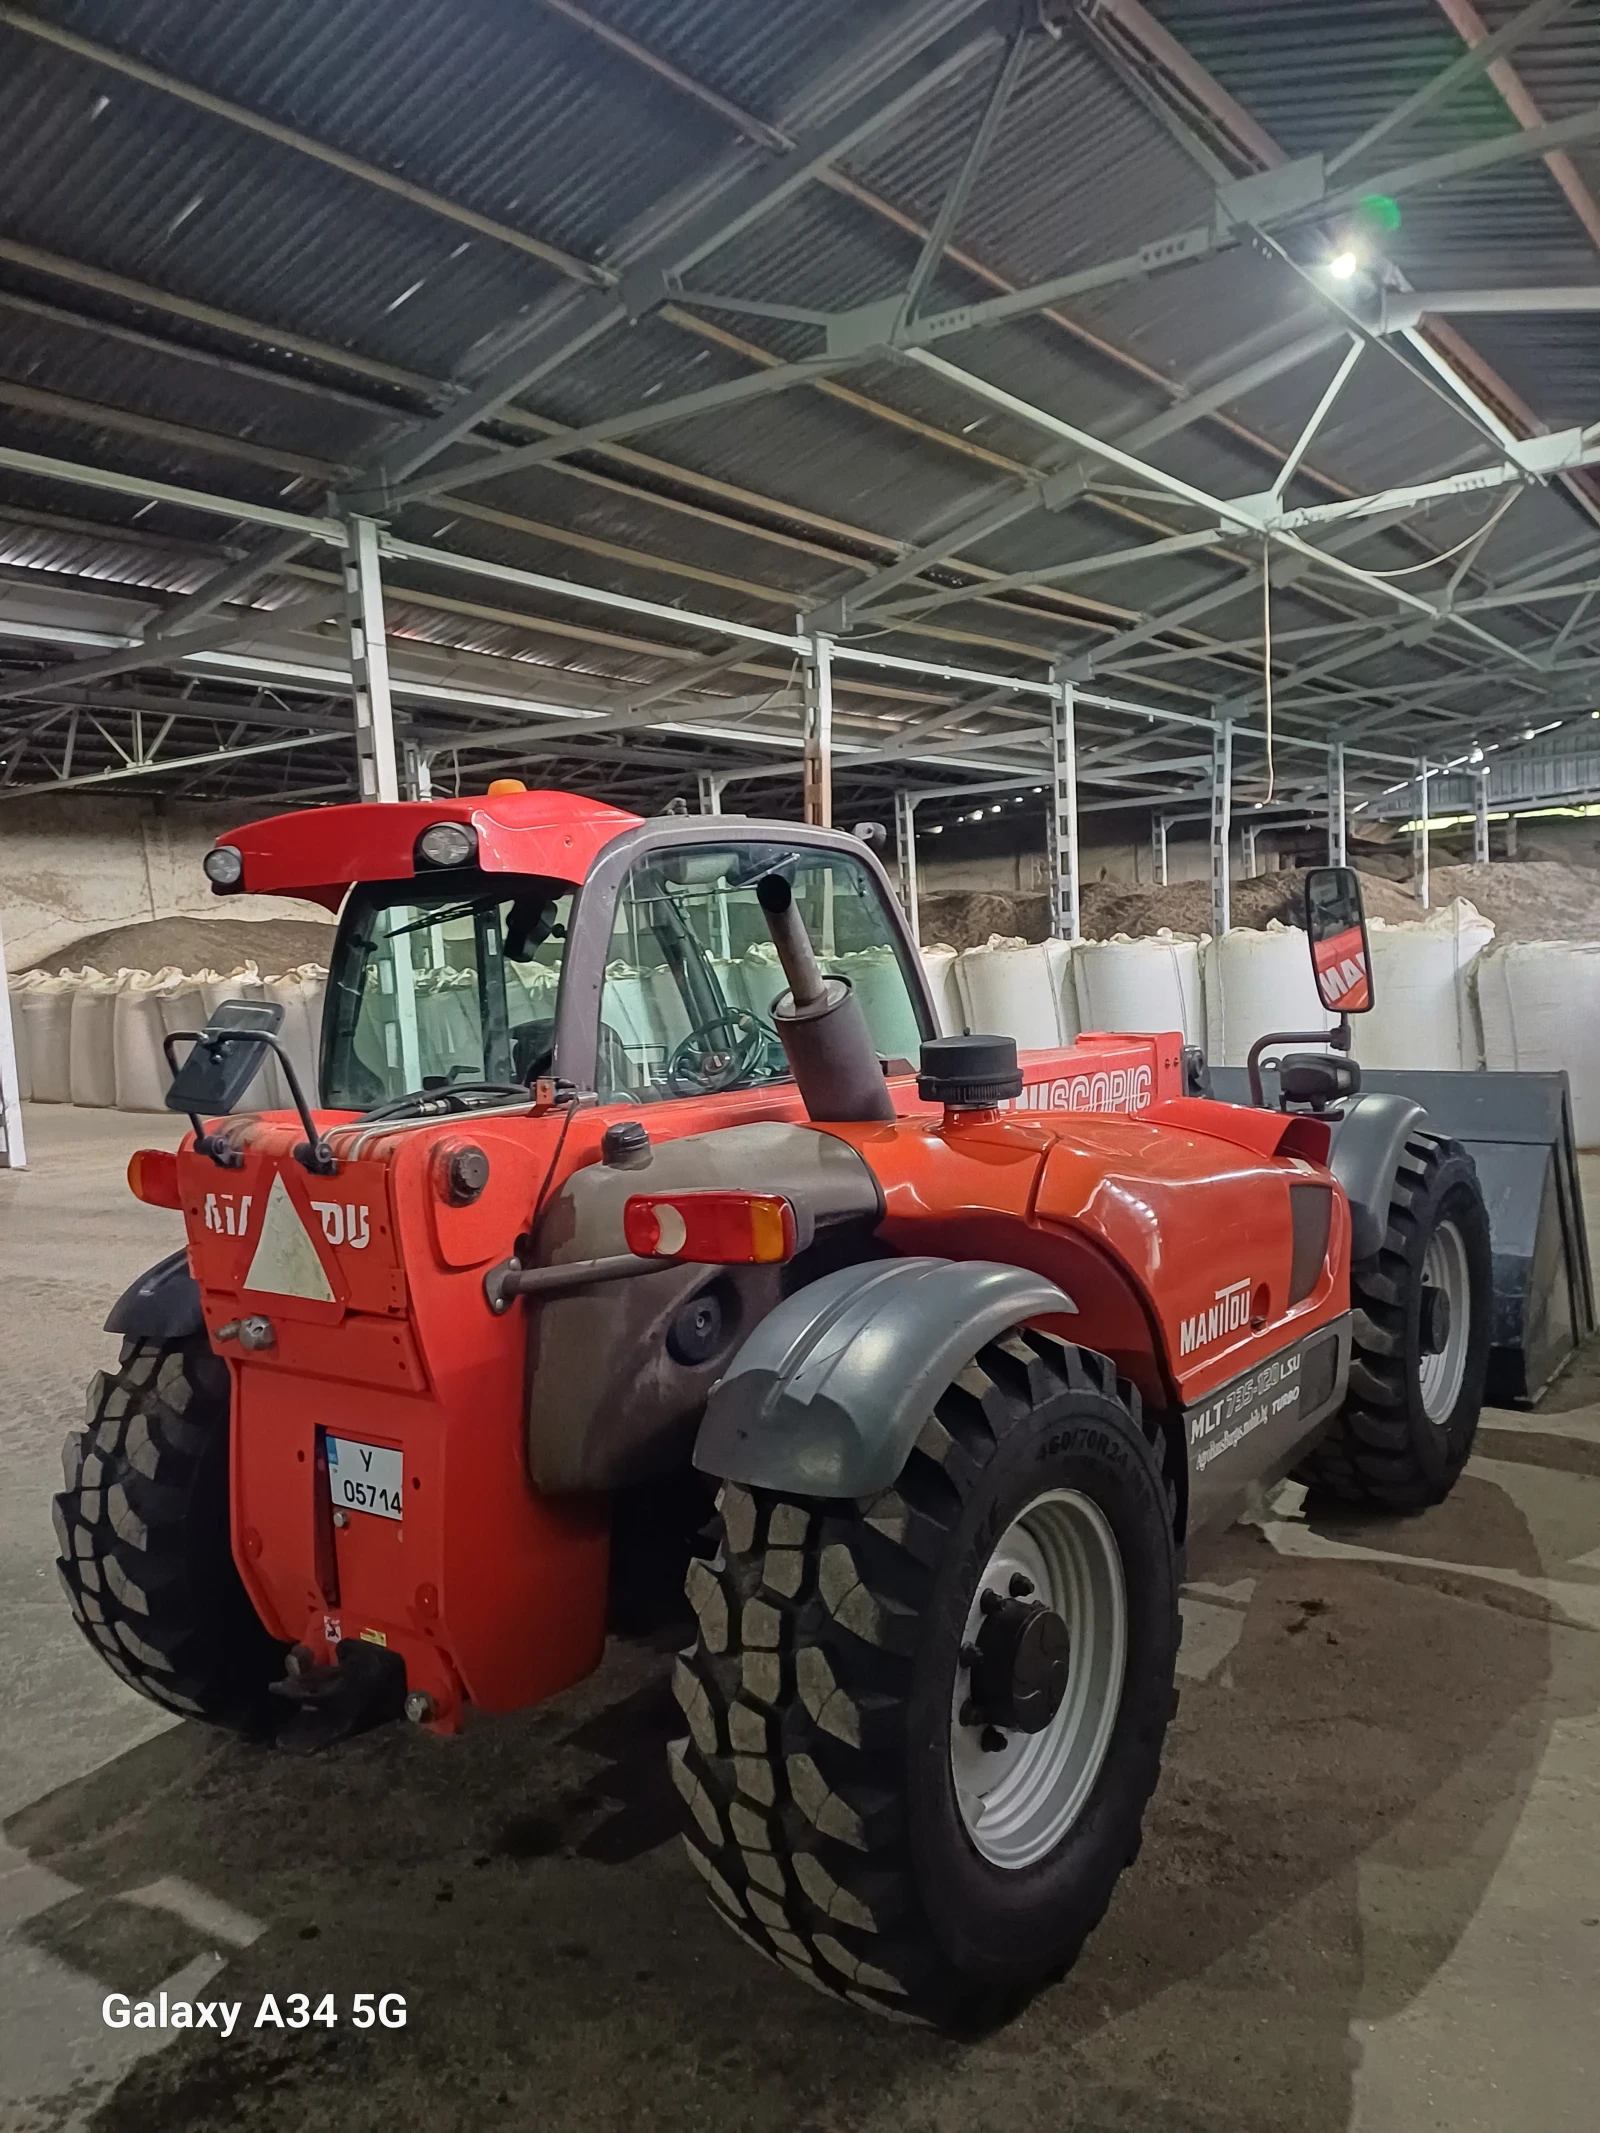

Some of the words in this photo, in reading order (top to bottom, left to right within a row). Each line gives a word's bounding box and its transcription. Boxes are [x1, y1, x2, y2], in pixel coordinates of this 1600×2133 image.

[1180, 1277, 1251, 1357] MANITOU
[1190, 1400, 1225, 1445] MLT
[1226, 1362, 1280, 1419] 735-120
[1280, 1353, 1301, 1382] LSU
[1271, 1385, 1300, 1415] TURBO
[343, 1479, 402, 1514] 05714
